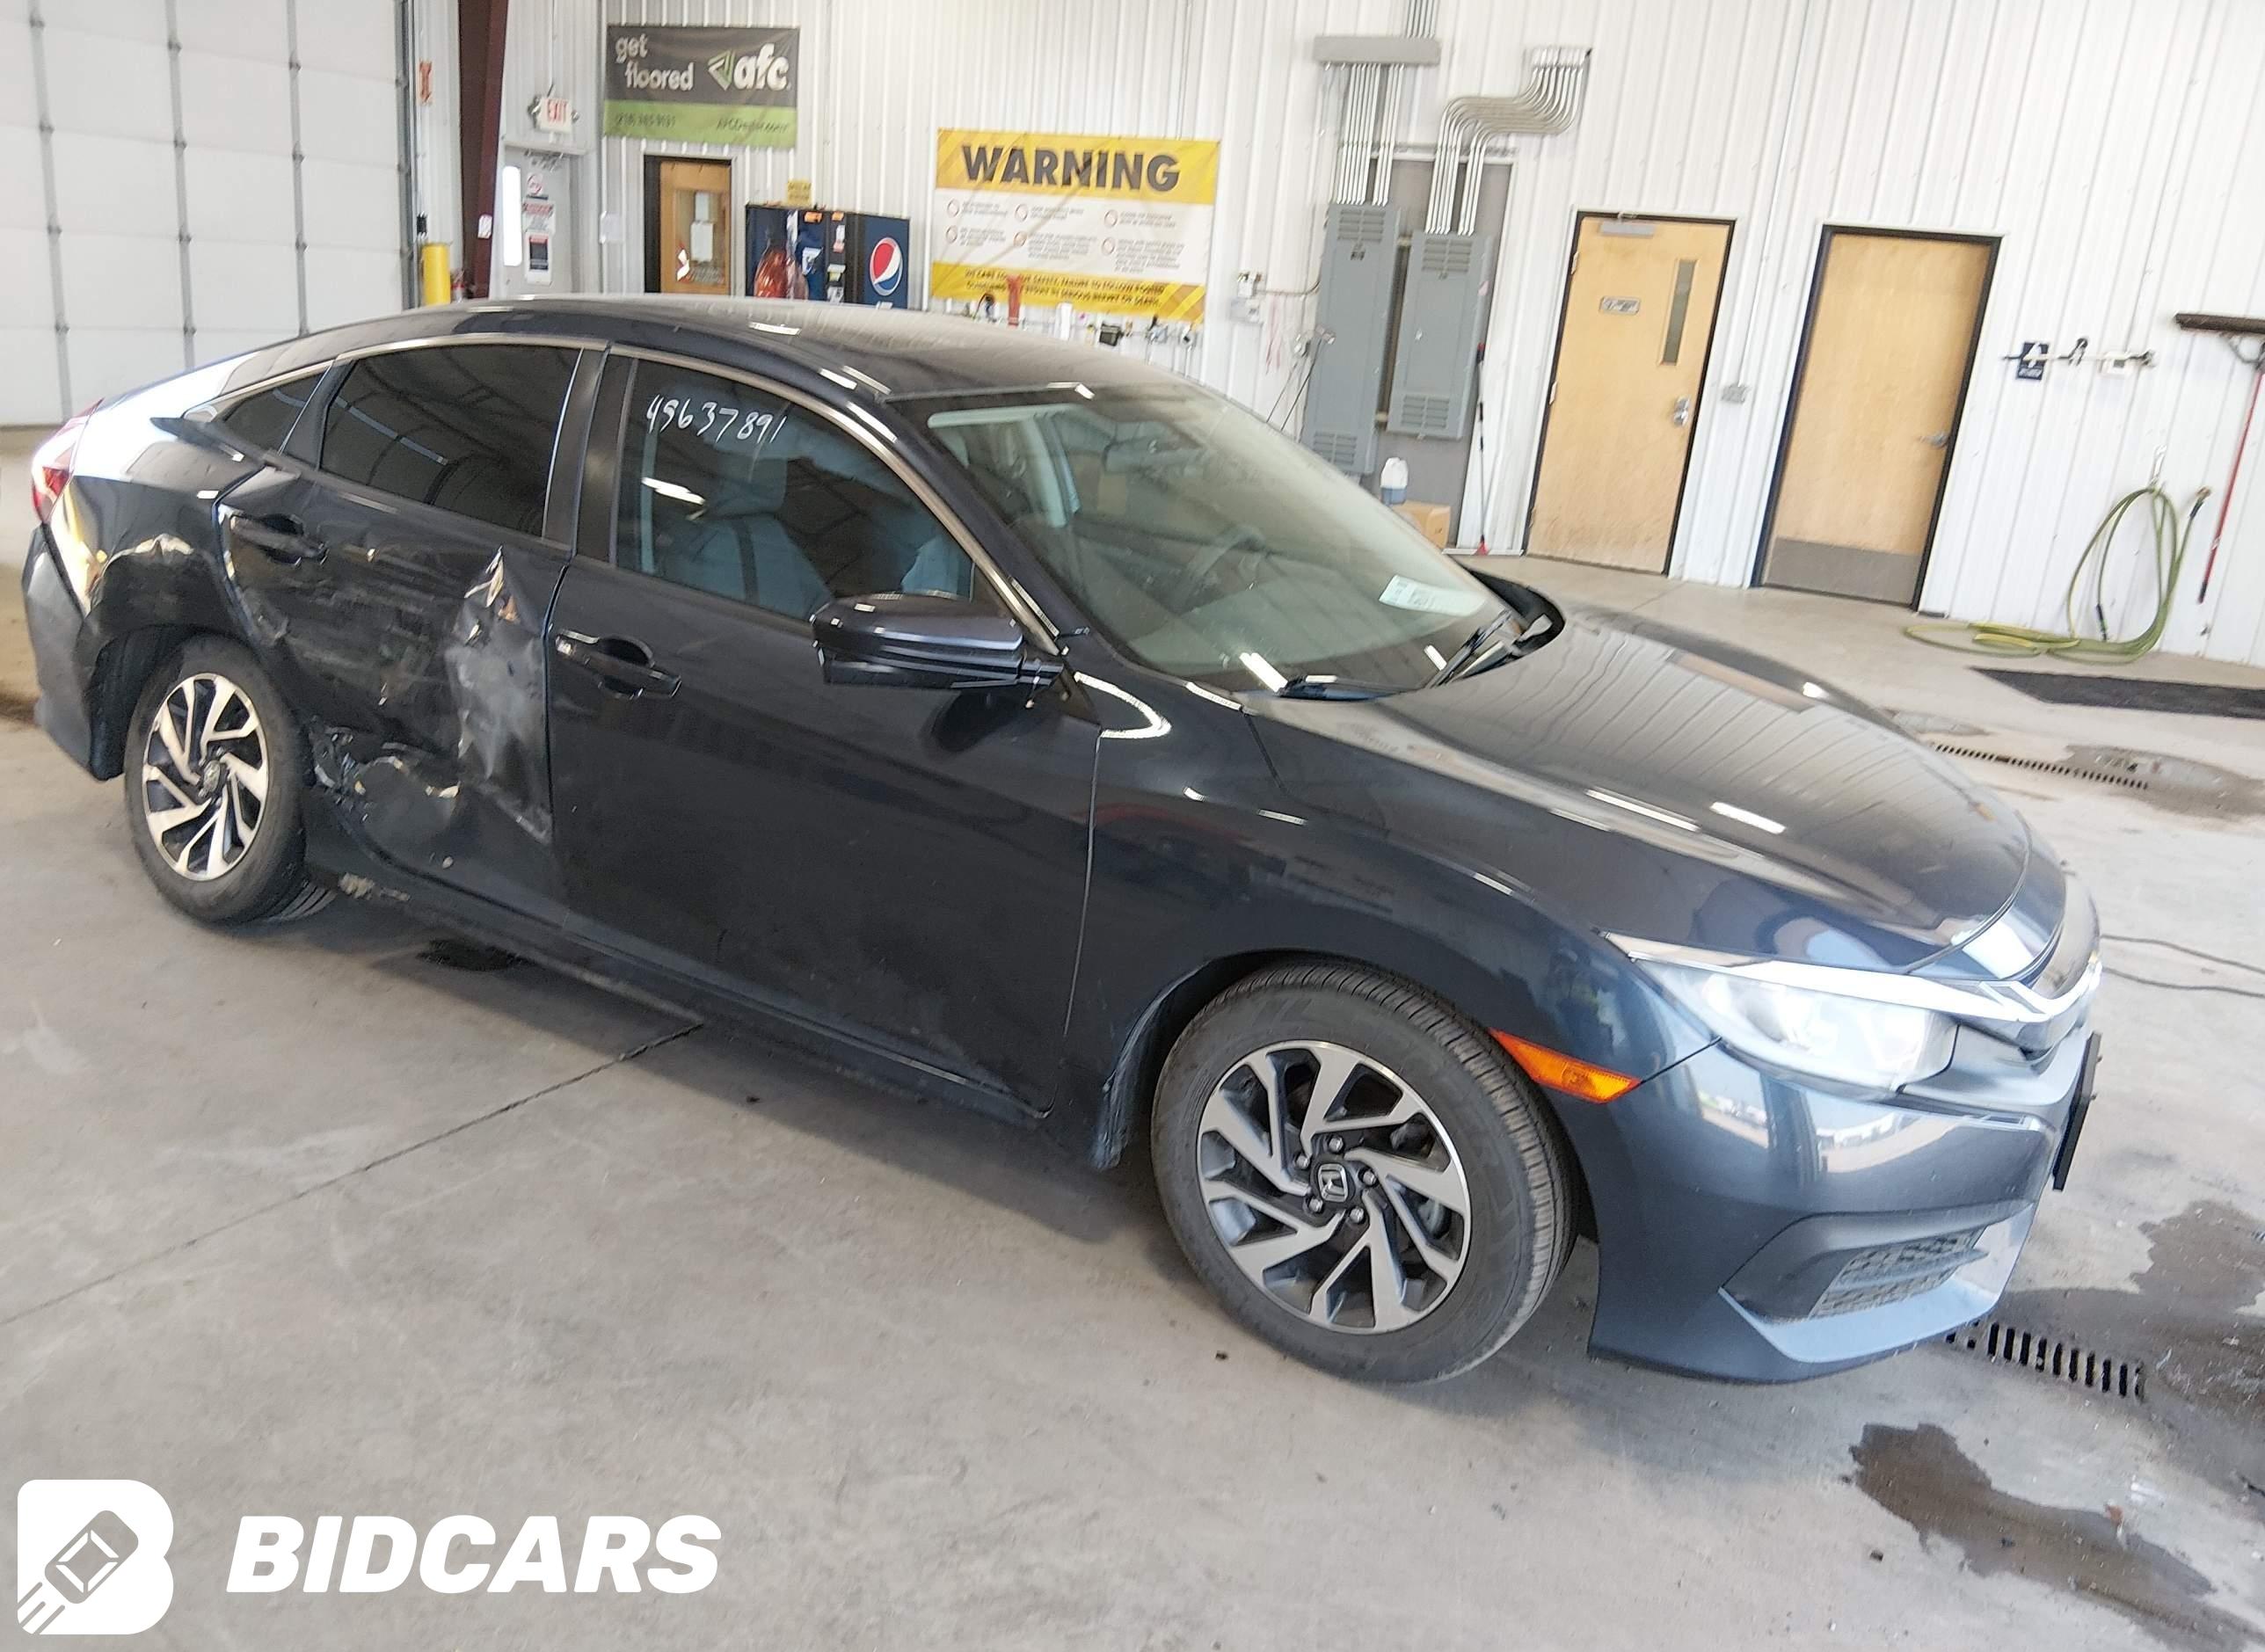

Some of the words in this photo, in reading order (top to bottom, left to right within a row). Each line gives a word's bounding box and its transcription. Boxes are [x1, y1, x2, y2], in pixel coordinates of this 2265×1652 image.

[615, 33, 648, 63] get
[625, 60, 694, 91] floored
[733, 43, 790, 91] afc
[546, 98, 568, 122] EXIT
[962, 145, 1181, 193] WARNING
